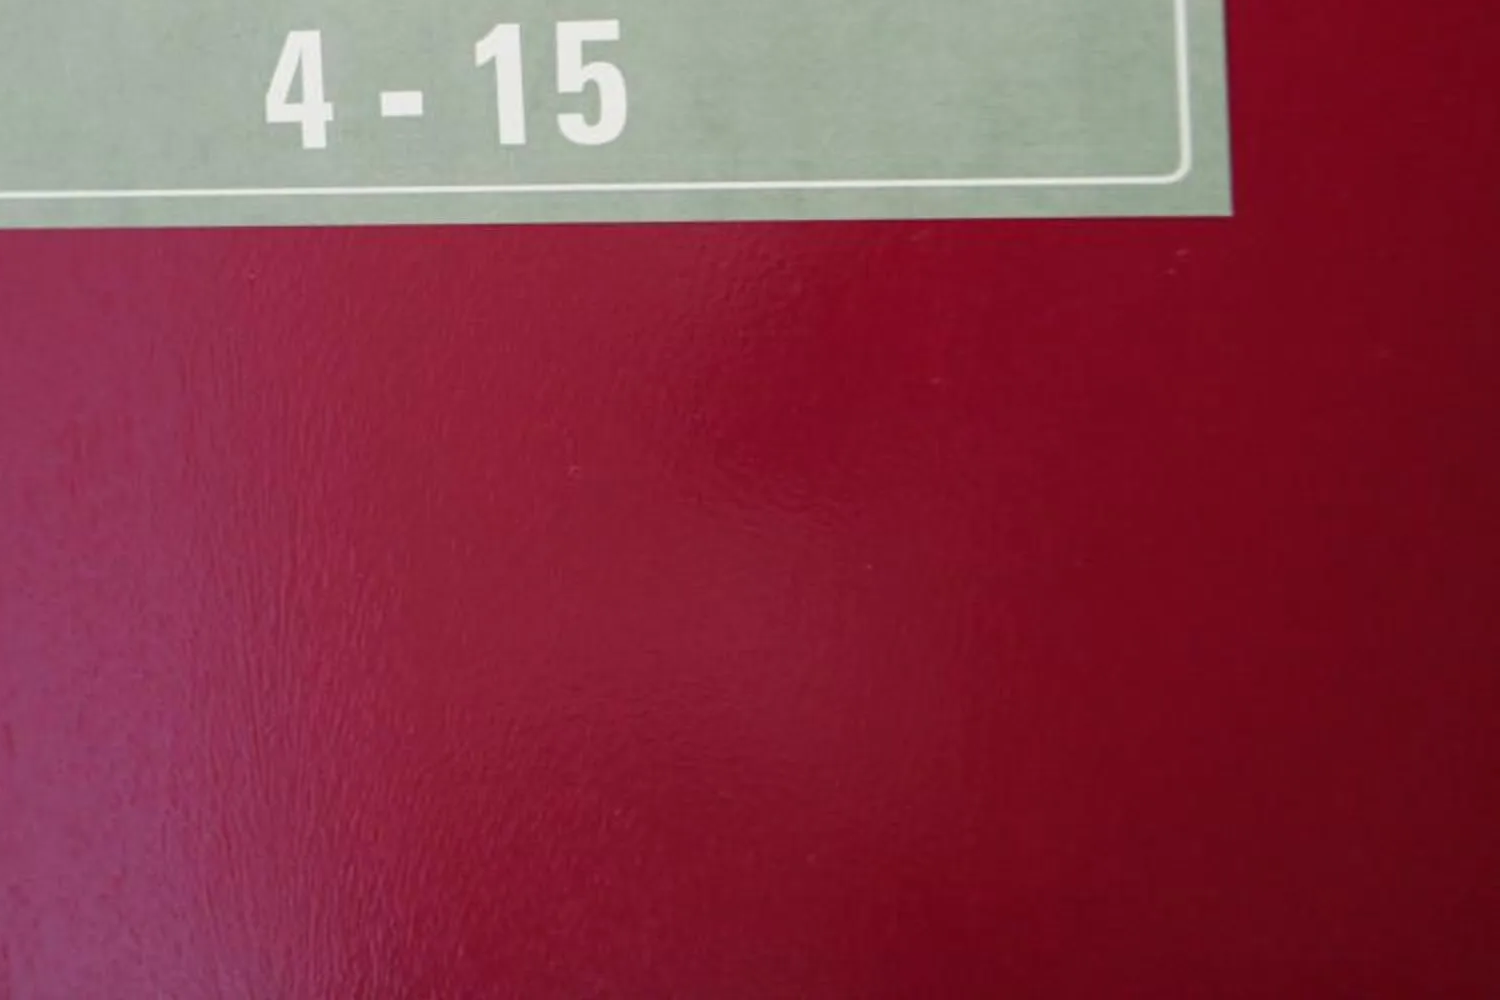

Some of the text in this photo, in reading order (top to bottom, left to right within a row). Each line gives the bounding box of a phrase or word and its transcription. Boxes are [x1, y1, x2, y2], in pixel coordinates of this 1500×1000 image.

[264, 19, 628, 150] 4 - 15
